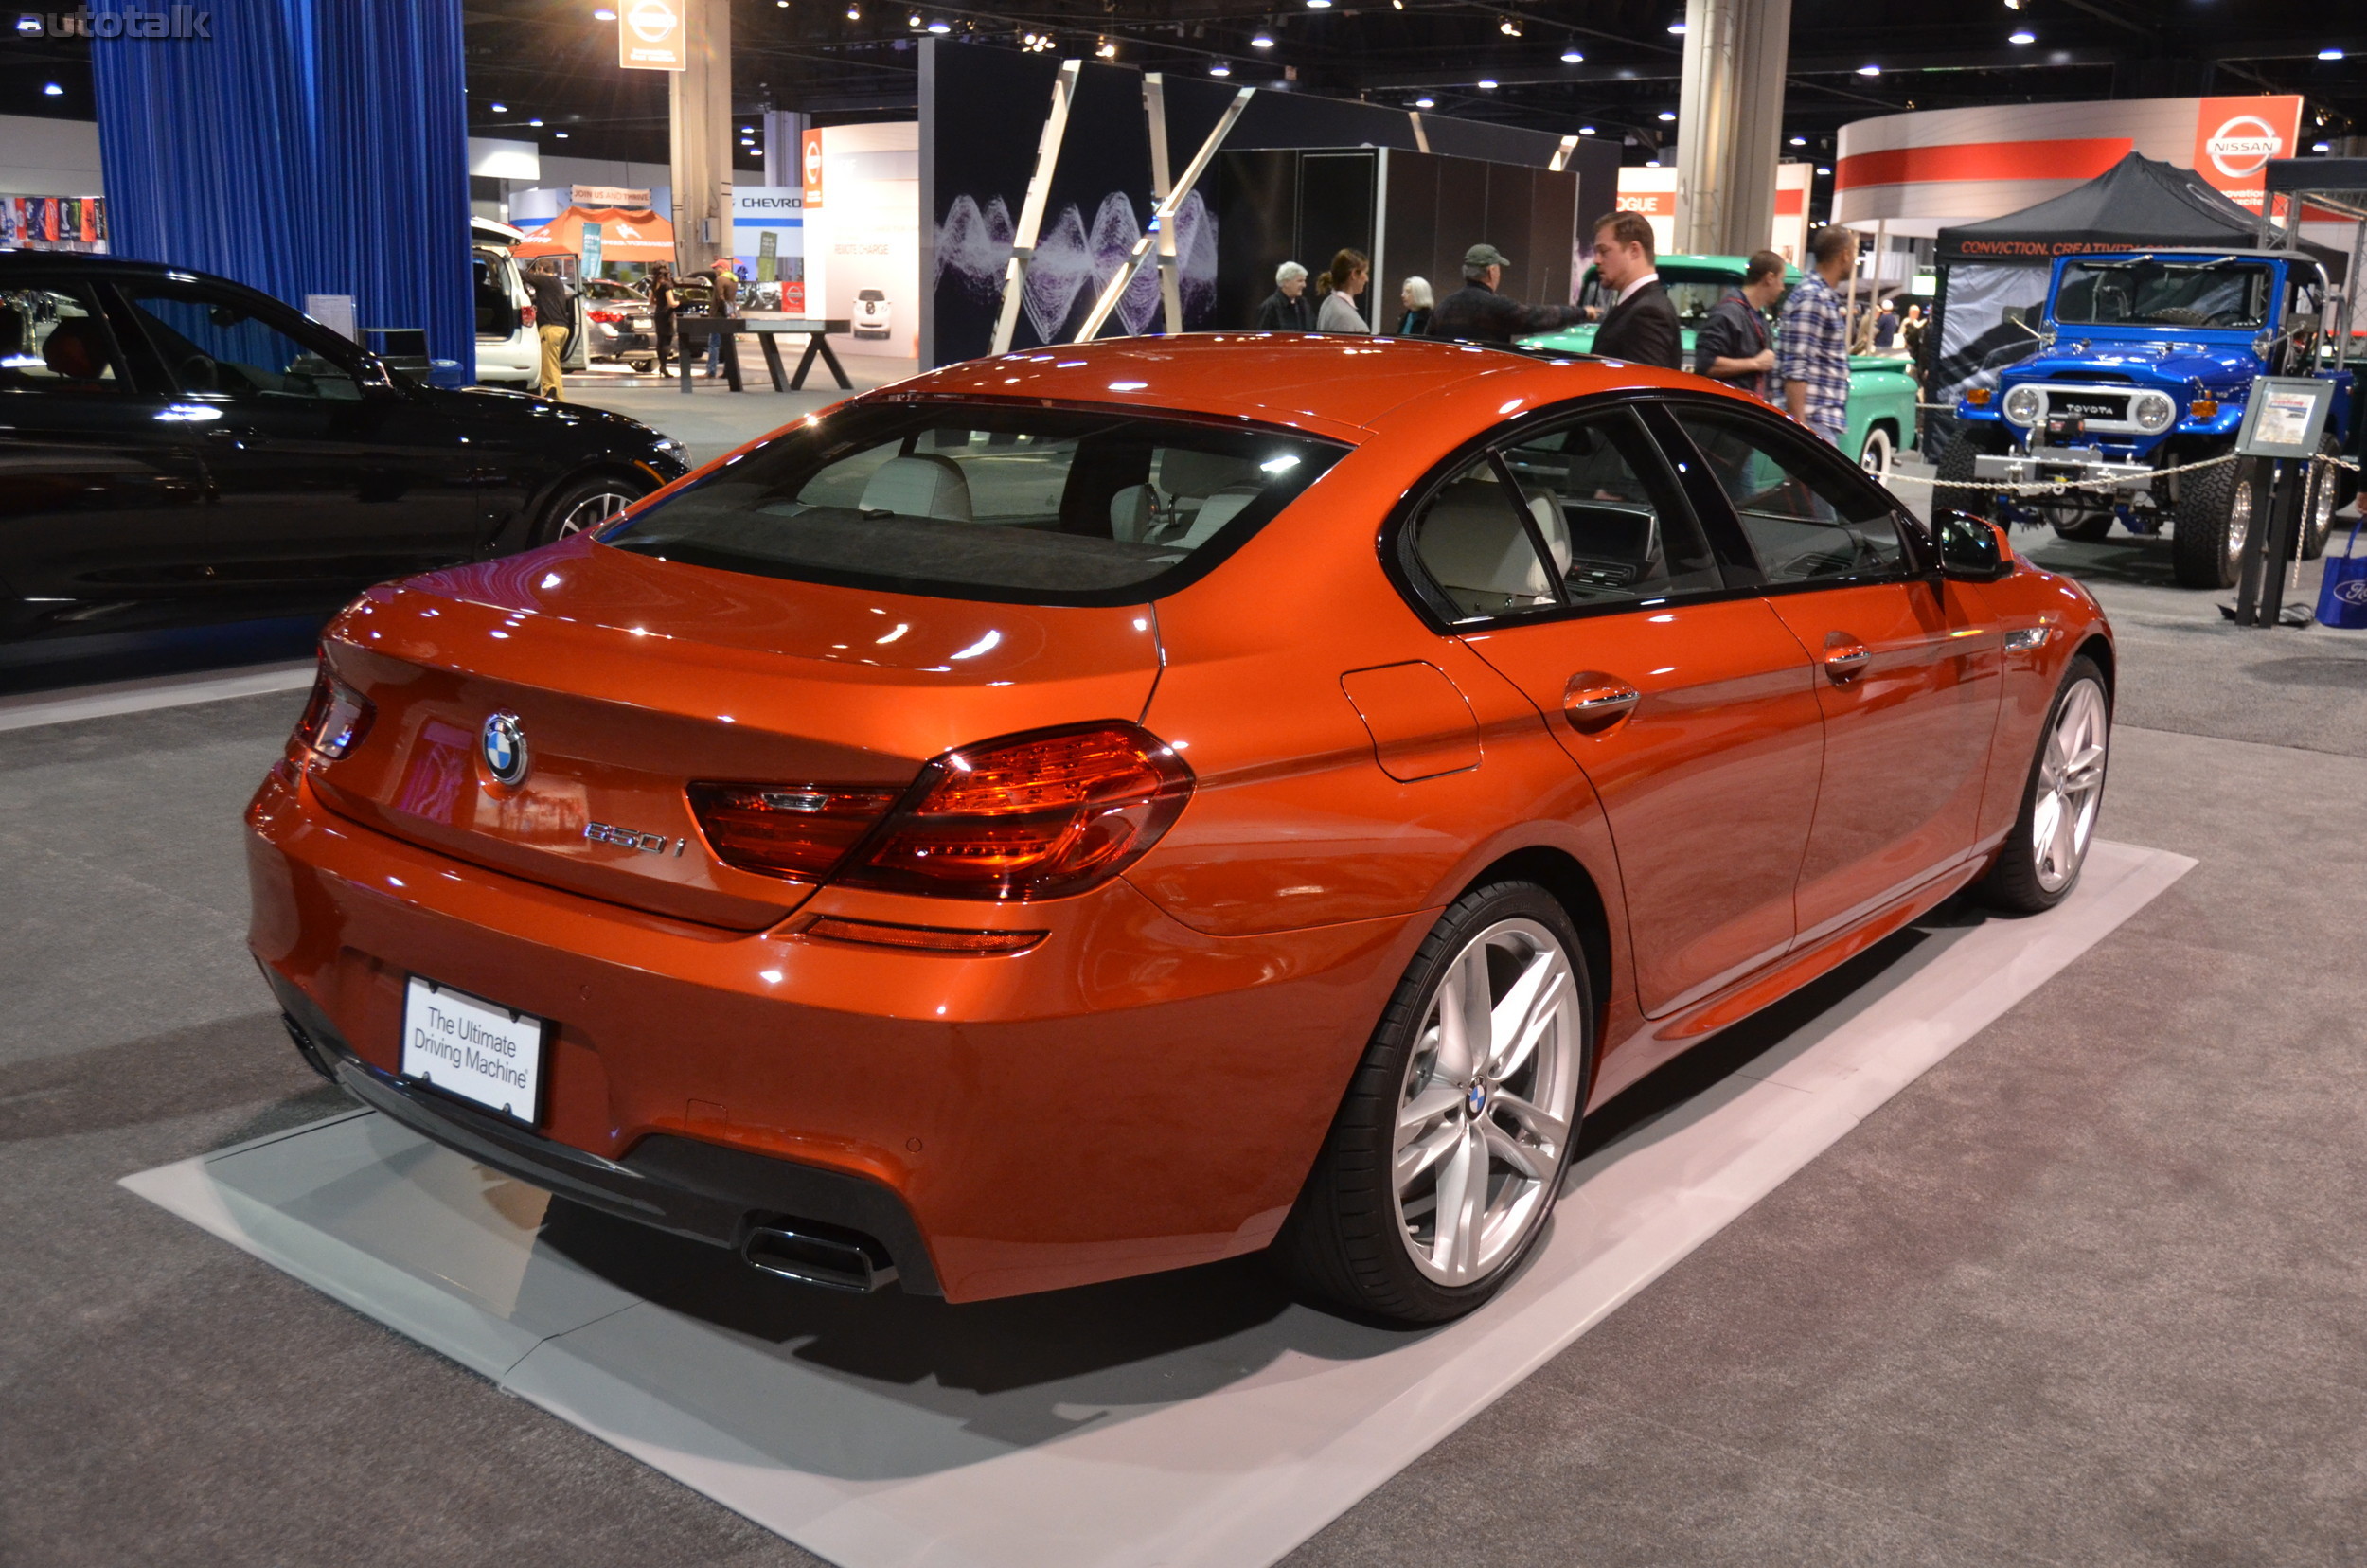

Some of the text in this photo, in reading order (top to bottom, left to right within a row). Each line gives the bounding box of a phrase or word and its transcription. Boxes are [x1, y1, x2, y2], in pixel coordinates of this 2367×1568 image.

[2214, 142, 2273, 151] NISSAN
[574, 189, 650, 202] JOIN US AND THRIVE
[742, 197, 802, 208] CHEVRO
[2066, 404, 2113, 415] TOYOTA
[428, 1006, 517, 1058] The Ultimate
[414, 1027, 462, 1069] Driving
